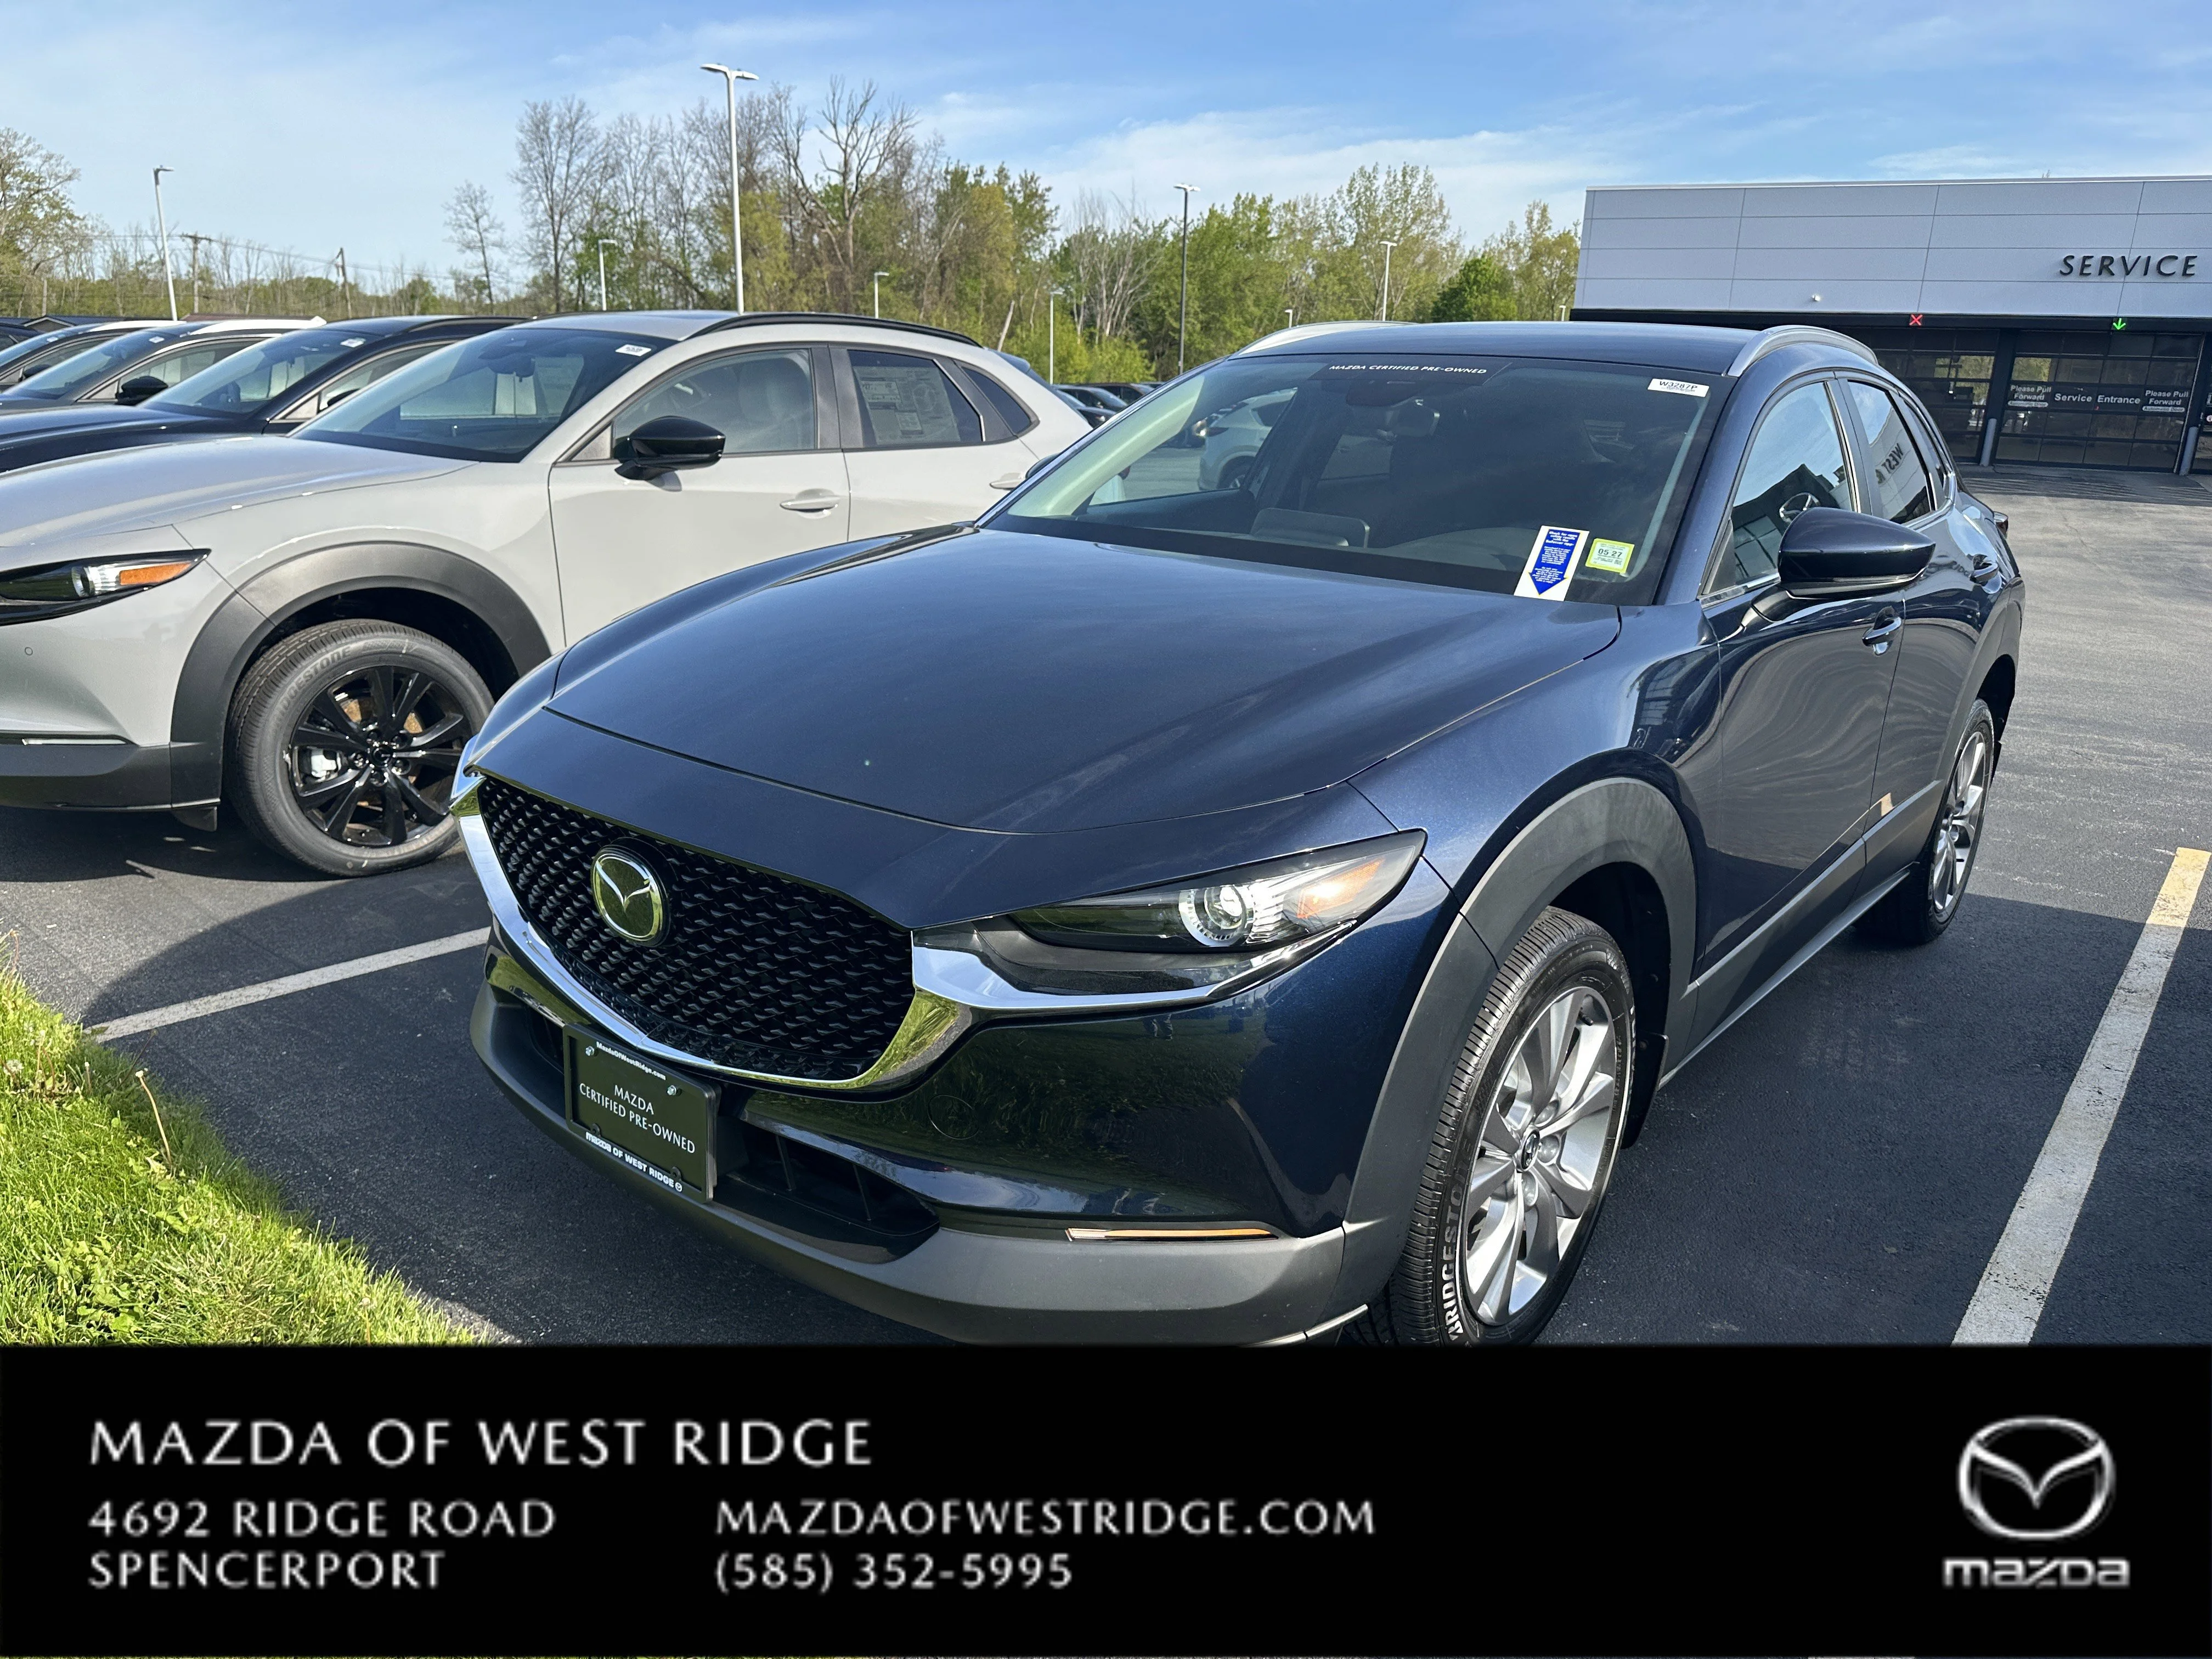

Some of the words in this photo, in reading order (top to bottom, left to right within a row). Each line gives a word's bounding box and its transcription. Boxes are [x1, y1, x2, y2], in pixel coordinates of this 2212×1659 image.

[2059, 255, 2198, 276] SERVICE
[2055, 393, 2092, 402] Service
[2097, 395, 2141, 404] Entrance
[614, 1085, 654, 1115] MAZDA
[579, 1083, 626, 1118] CERTIFIED
[629, 1110, 695, 1154] PRE-OWNED
[613, 1147, 623, 1159] OF
[625, 1153, 648, 1172] WEST
[649, 1167, 674, 1188] RIDGE
